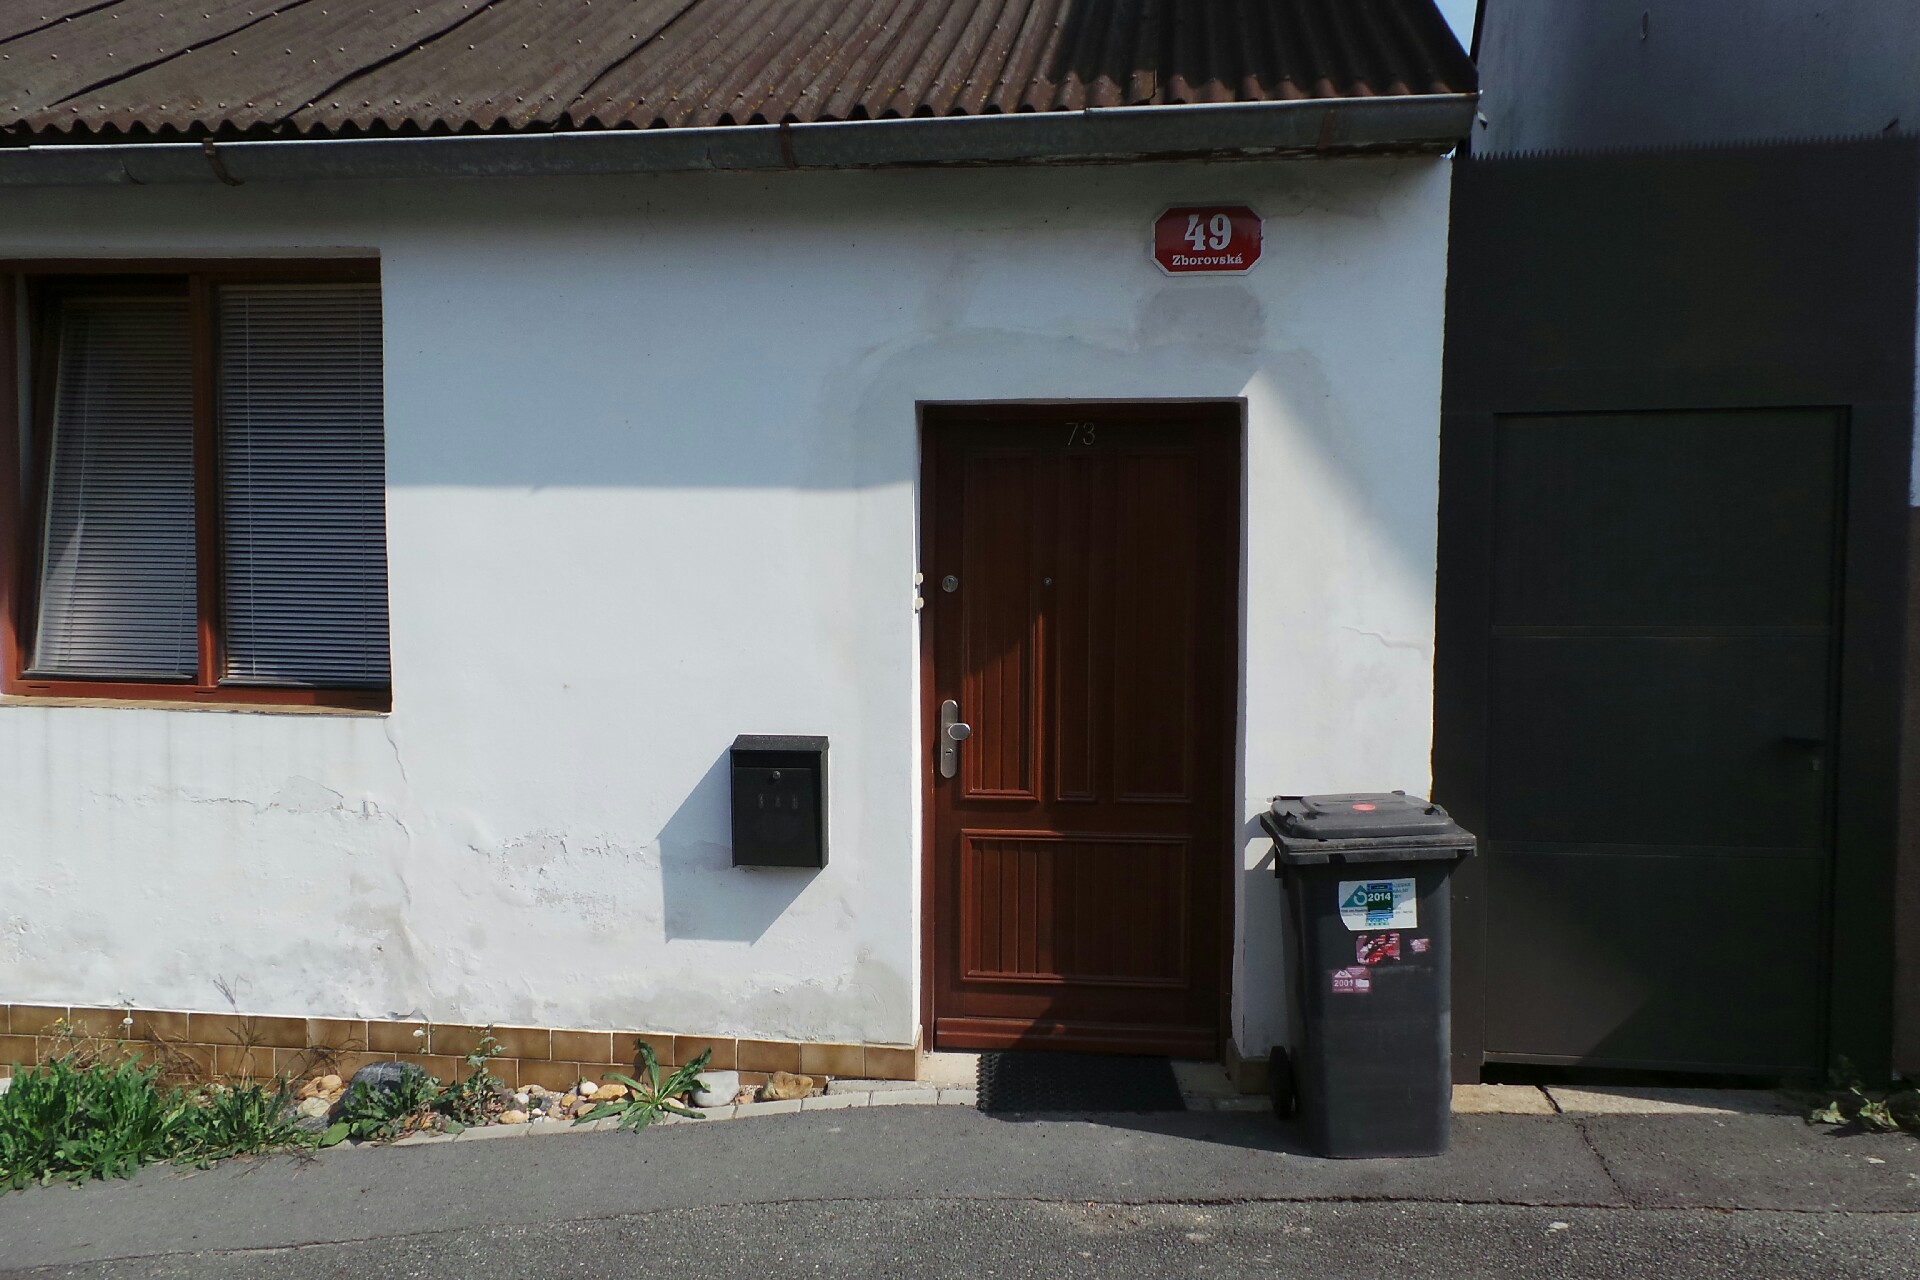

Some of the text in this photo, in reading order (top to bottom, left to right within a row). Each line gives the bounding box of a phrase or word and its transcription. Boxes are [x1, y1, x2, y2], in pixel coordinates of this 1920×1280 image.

[1184, 213, 1232, 251] 49
[1172, 253, 1243, 266] Zborovská
[1064, 422, 1096, 446] 73
[1367, 892, 1391, 901] 2014
